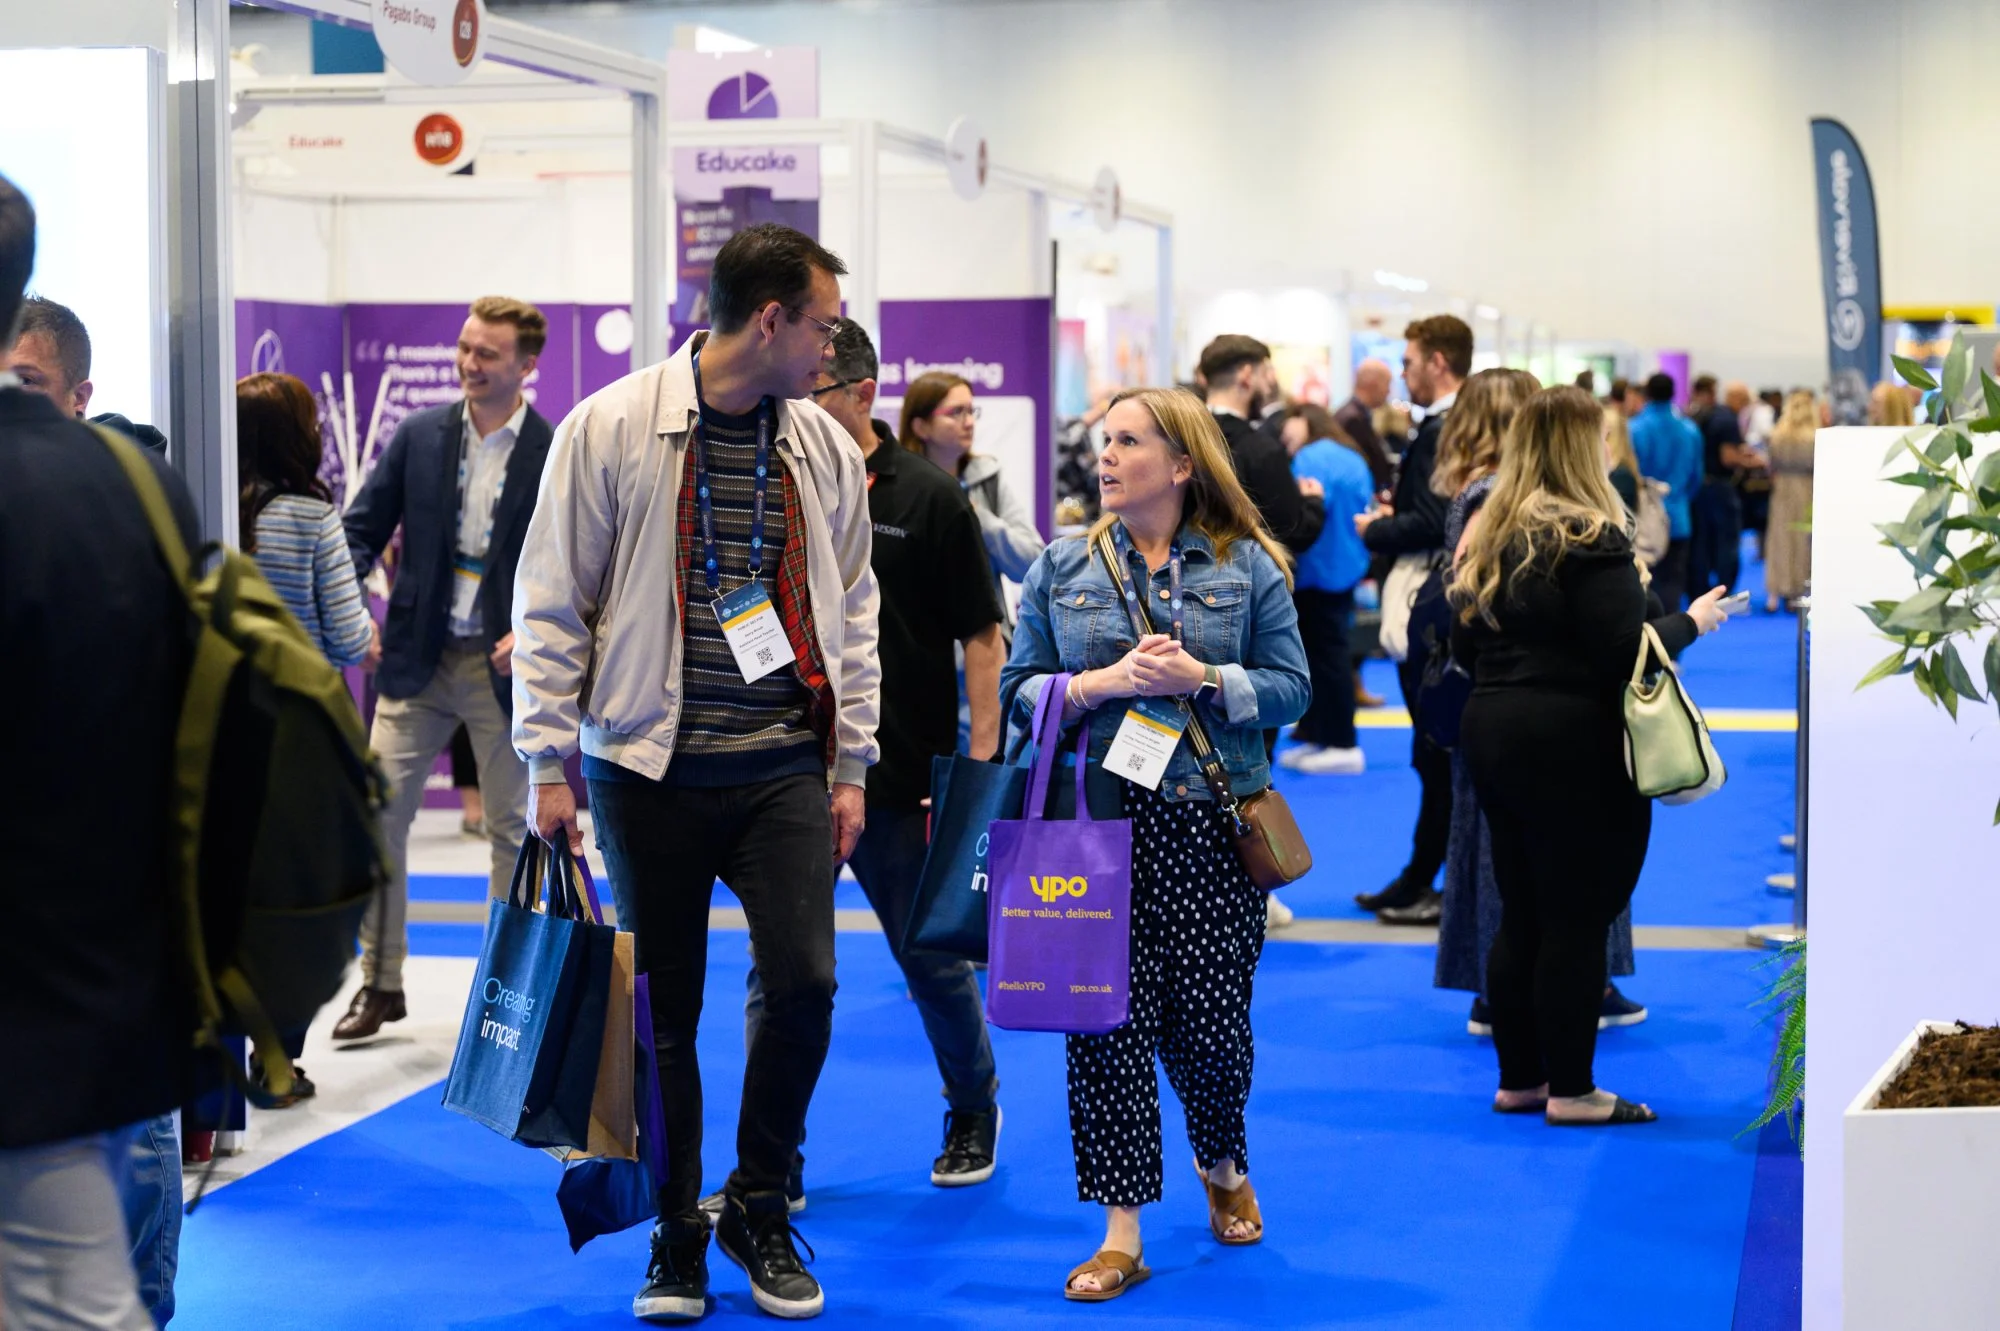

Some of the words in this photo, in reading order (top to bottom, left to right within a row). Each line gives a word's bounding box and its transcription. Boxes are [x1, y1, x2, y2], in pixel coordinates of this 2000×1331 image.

[413, 8, 436, 32] Group
[289, 136, 344, 148] Educake
[696, 151, 797, 172] Educake
[1029, 876, 1087, 902] ypo
[1002, 907, 1031, 917] Better
[1034, 908, 1063, 919] value,
[1066, 908, 1114, 919] delivered.
[998, 981, 1045, 991] #helloYPO
[1069, 984, 1112, 994] ypo.co.uk
[480, 1012, 521, 1051] impact
